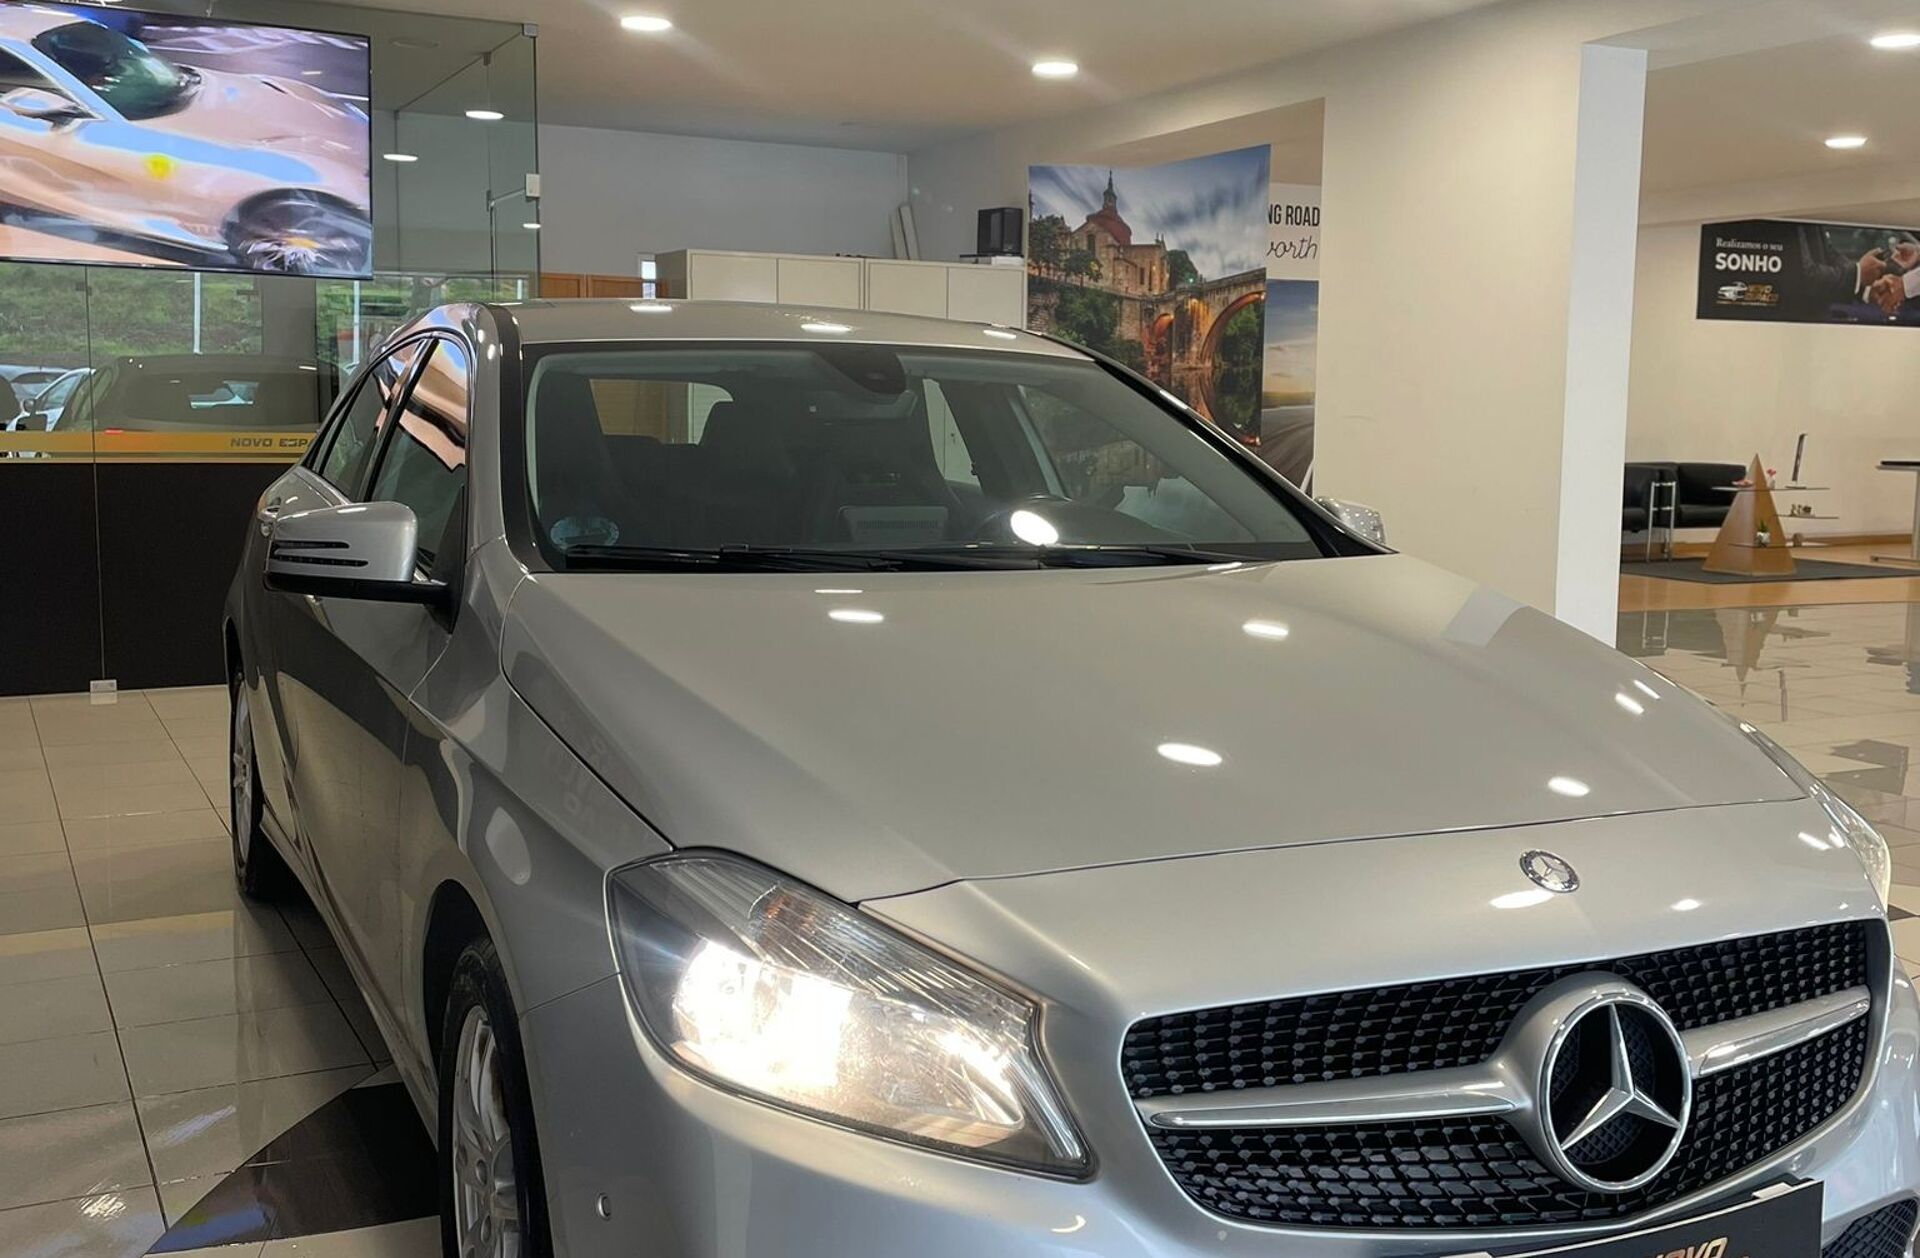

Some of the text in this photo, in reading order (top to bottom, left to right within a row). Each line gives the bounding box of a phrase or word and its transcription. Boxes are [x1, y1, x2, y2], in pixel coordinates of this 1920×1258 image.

[1285, 205, 1320, 227] ROAD
[1267, 235, 1318, 260] orth
[1715, 252, 1782, 273] SONHO
[230, 437, 313, 448] NOVO ESP
